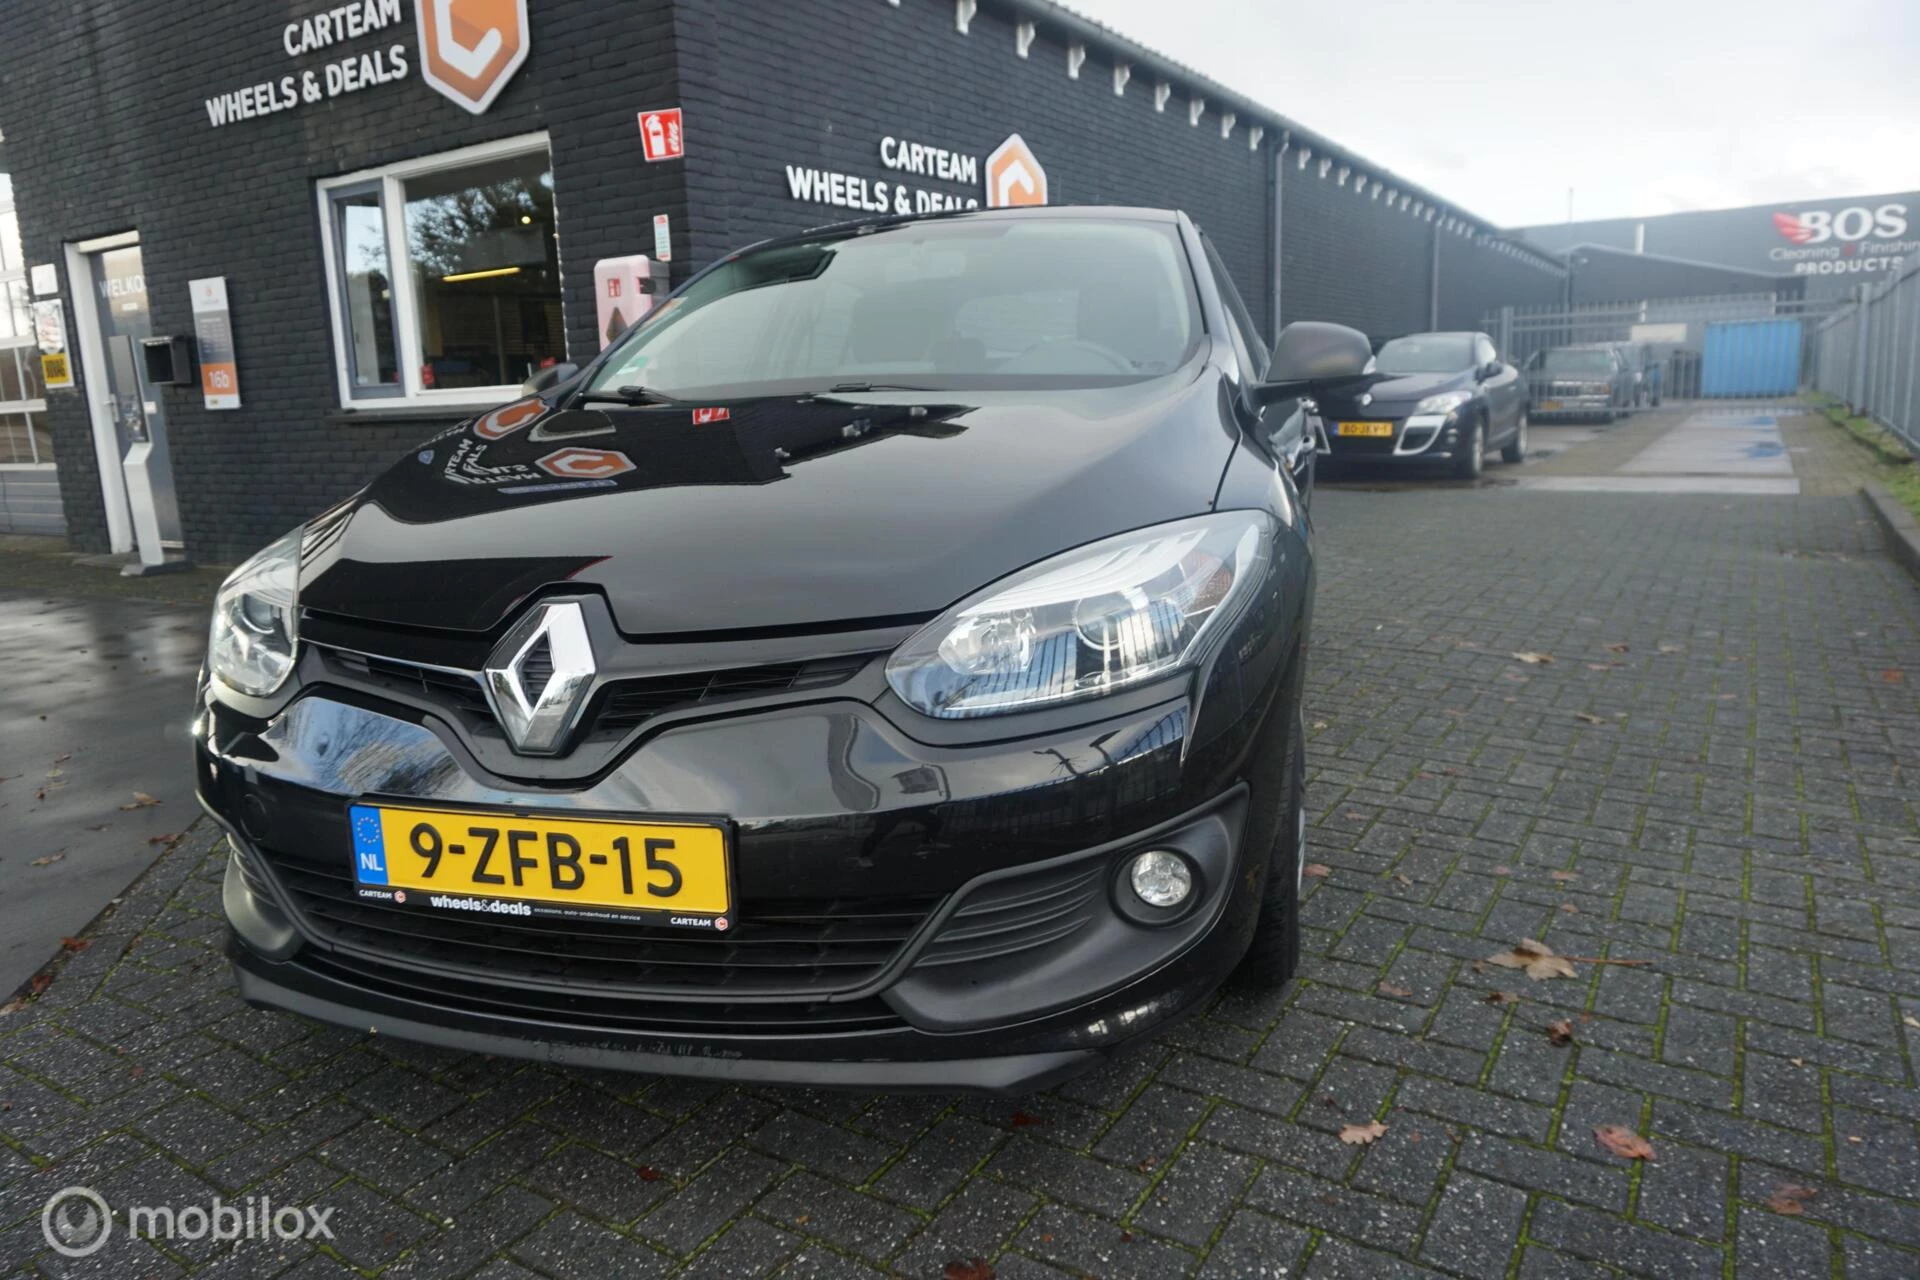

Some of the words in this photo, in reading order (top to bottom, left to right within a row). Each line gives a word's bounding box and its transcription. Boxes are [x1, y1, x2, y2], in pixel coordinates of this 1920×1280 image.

[283, 0, 401, 56] CARTEAM
[206, 76, 298, 127] WHEELS
[302, 70, 322, 103] &
[325, 45, 408, 97] DEALS
[880, 136, 977, 184] CARTEAM
[786, 165, 888, 212] WHEELS
[894, 184, 911, 215] &
[1798, 203, 1908, 244] BOS
[1860, 239, 1920, 255] Finishin
[1795, 256, 1905, 275] PRODUCTS
[99, 274, 147, 298] WELKO
[360, 852, 384, 871] NL
[409, 822, 683, 898] 9-ZFB-15
[359, 889, 393, 899] CARTEAM
[430, 895, 532, 916] wheels&deals
[670, 916, 711, 928] CARTEAM
